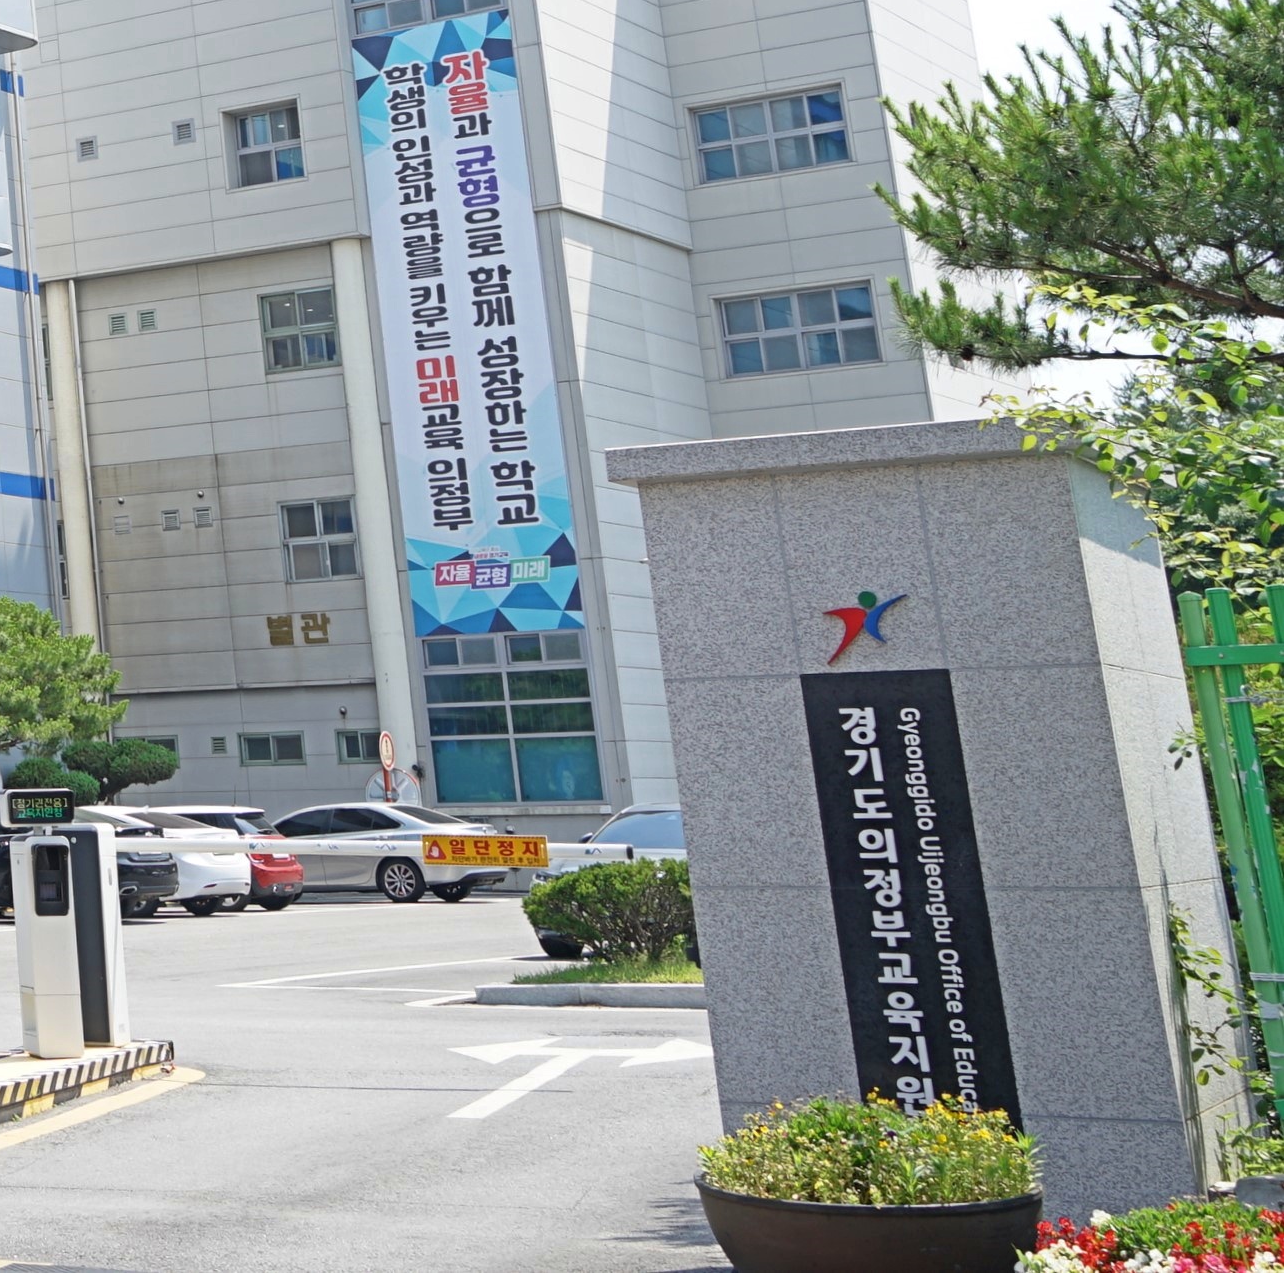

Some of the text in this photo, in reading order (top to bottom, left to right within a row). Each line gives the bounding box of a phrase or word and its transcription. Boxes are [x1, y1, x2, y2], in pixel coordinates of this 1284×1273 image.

[442, 50, 493, 140] 자율과
[455, 144, 506, 259] 균형으로
[383, 62, 474, 531] 학생의 인성과 역량을 키우는 미래교육 의정부
[467, 263, 516, 328] 함께
[477, 335, 529, 453] 성장하는
[490, 459, 540, 526] 학교
[438, 560, 546, 586] 자율 균형 미래
[266, 613, 331, 647] 별관
[838, 706, 936, 1117] 경기도의정부교육지원
[897, 706, 979, 1113] Gyeonggido Uijeongbu Office of Educa
